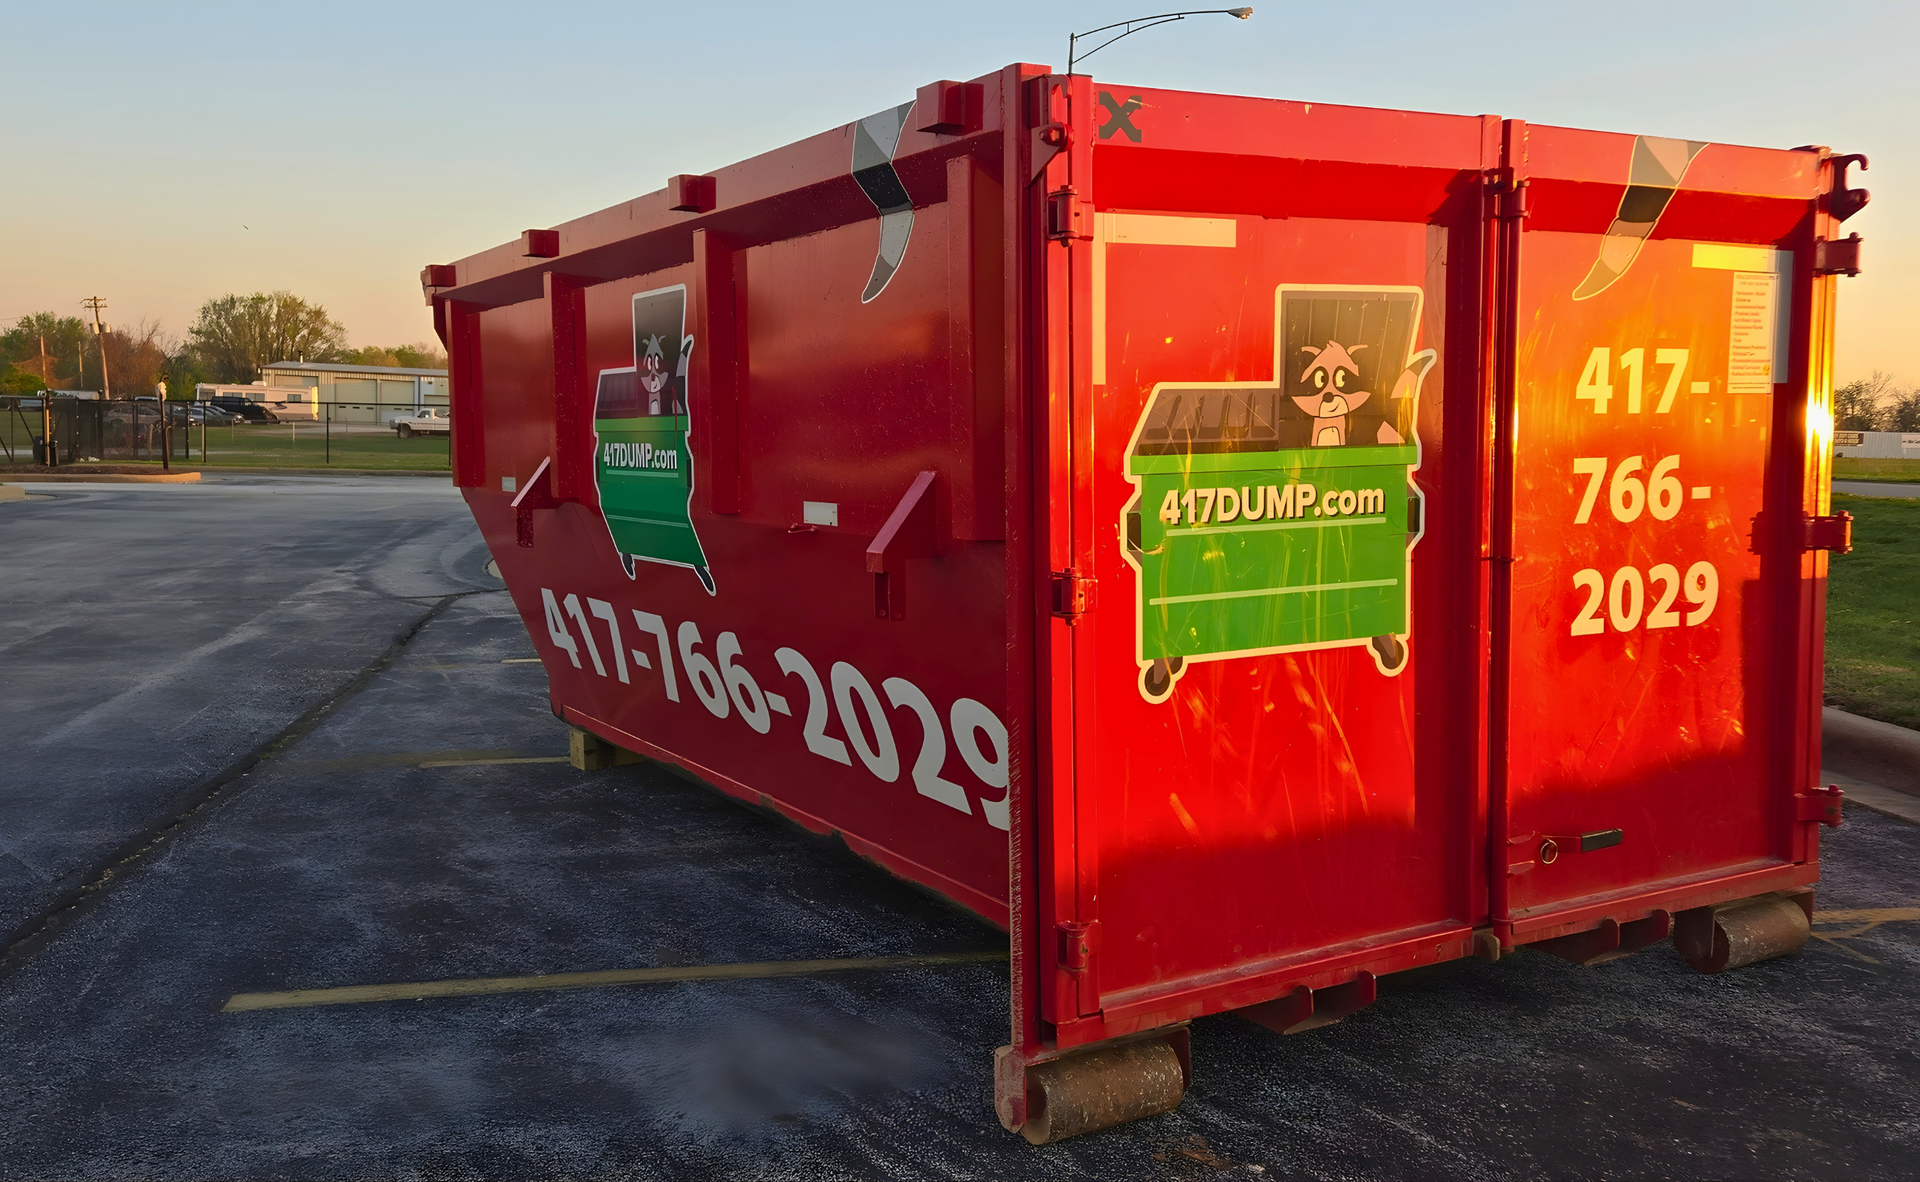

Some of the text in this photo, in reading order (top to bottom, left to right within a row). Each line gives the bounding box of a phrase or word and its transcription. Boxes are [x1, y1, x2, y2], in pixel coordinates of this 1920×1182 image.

[1575, 347, 1710, 414] 417-
[603, 443, 678, 470] 417DUMP.com
[1573, 454, 1711, 524] 766-
[1159, 484, 1385, 526] 417DUMP.com
[1570, 560, 1719, 637] 2029
[540, 587, 1010, 832] 417-766-2029
